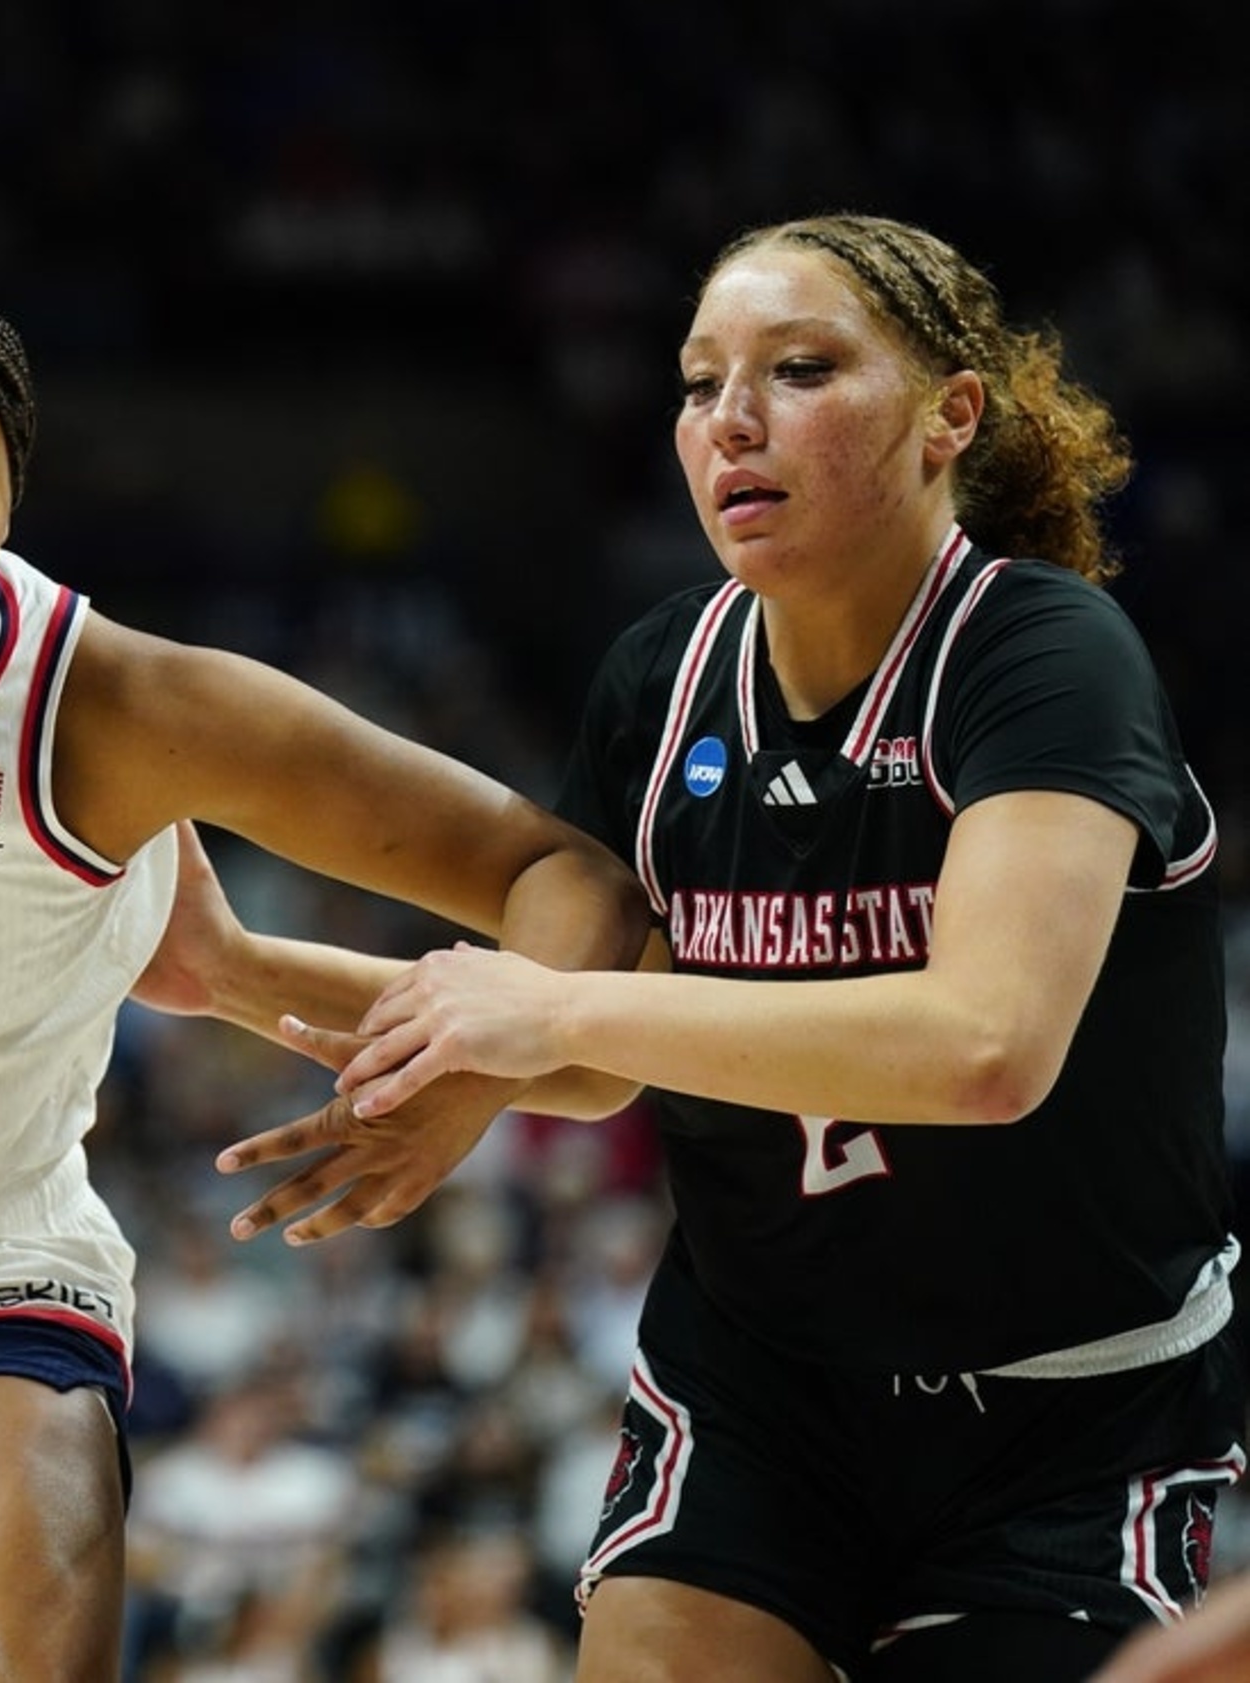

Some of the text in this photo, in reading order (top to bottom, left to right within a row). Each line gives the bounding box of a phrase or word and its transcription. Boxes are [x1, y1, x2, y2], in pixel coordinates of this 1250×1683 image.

[688, 763, 724, 784] NCAA
[670, 885, 934, 965] ARKANSAS STAT
